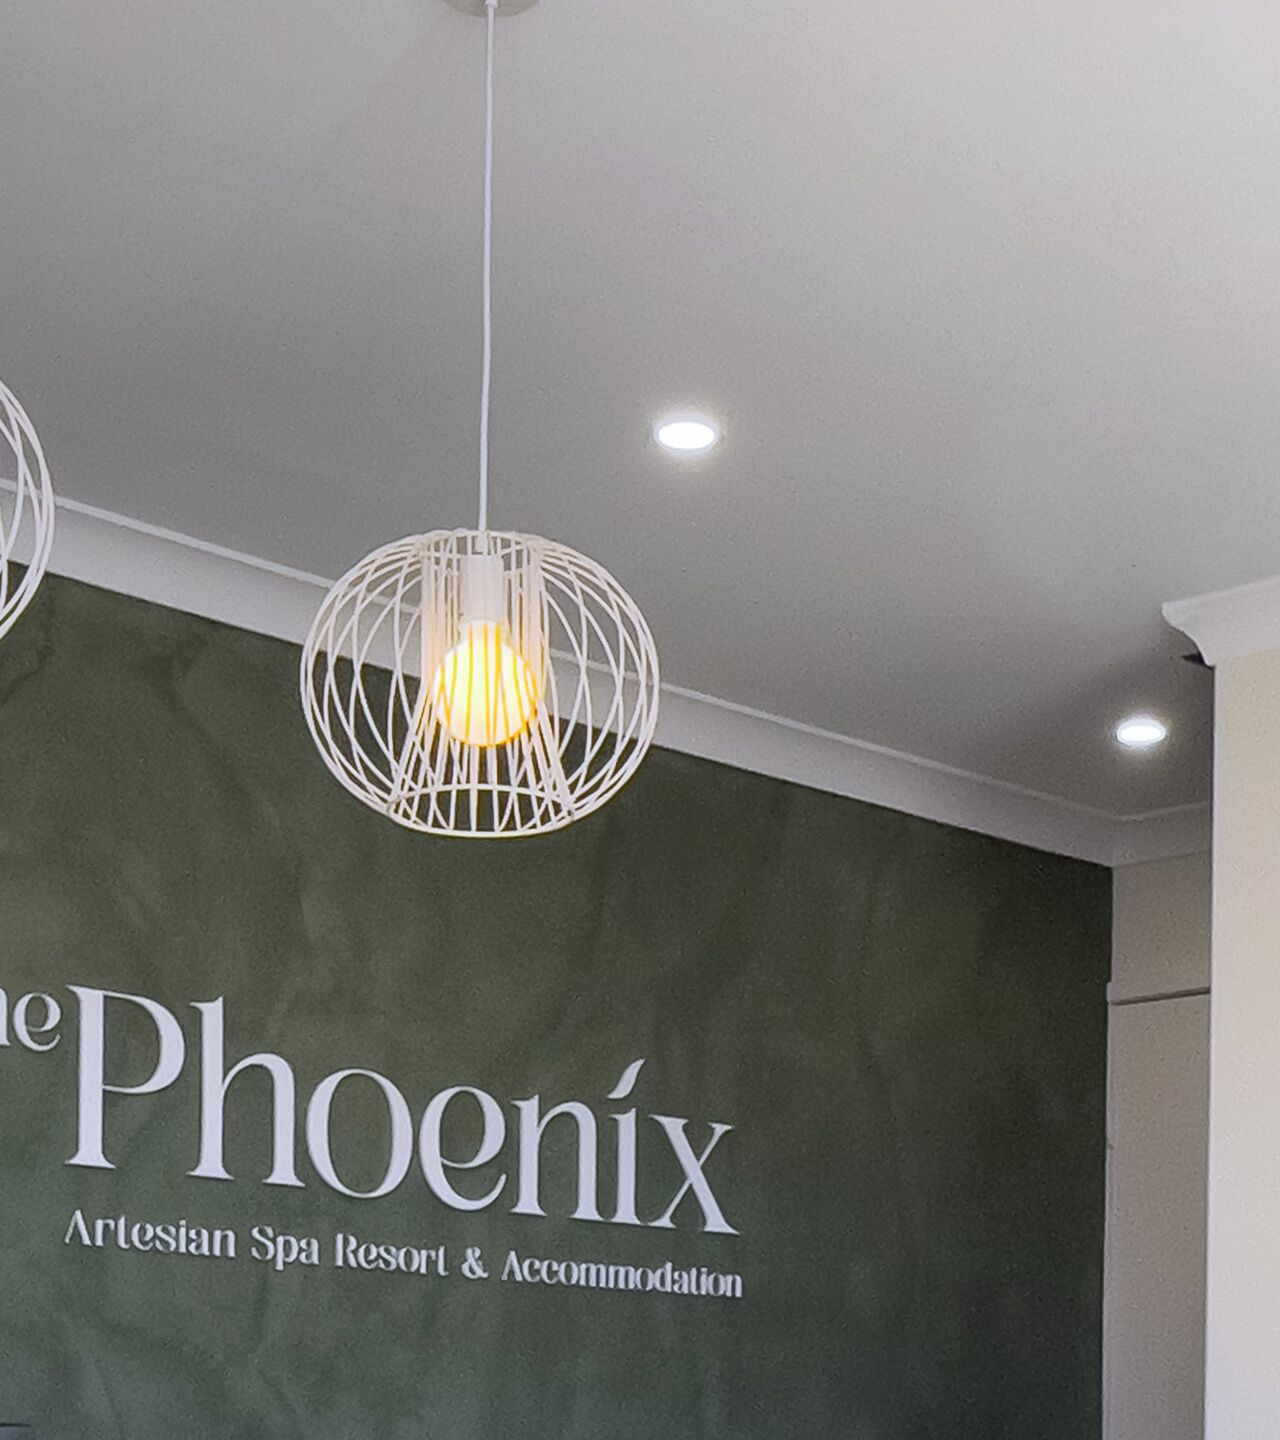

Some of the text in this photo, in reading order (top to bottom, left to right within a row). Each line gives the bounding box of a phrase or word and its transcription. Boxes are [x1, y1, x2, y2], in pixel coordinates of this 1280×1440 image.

[64, 1208, 743, 1298] Artesian Spa Resort & Accommodation
